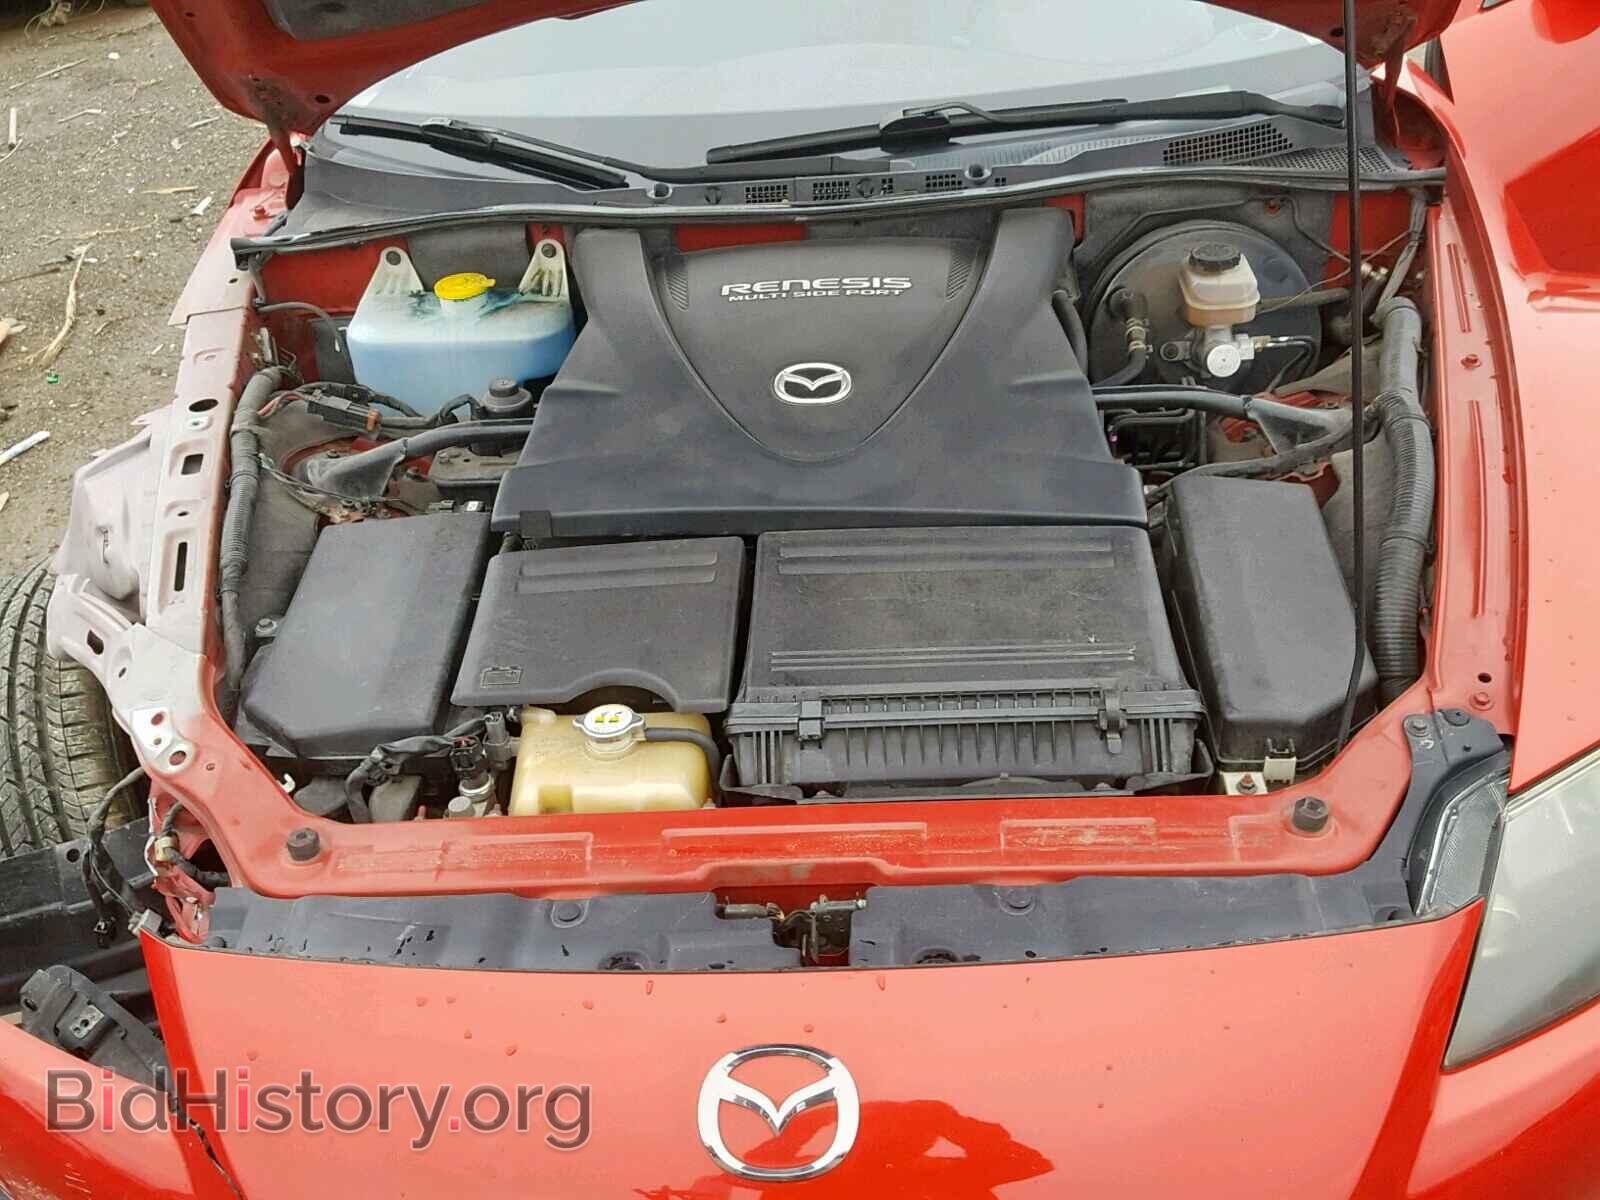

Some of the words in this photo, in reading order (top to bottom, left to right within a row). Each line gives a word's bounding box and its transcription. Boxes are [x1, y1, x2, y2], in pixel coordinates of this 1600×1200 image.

[720, 276, 913, 297] RENESIS
[728, 292, 788, 303] MULTI
[793, 289, 841, 298] SIDE
[845, 288, 905, 297] PORT
